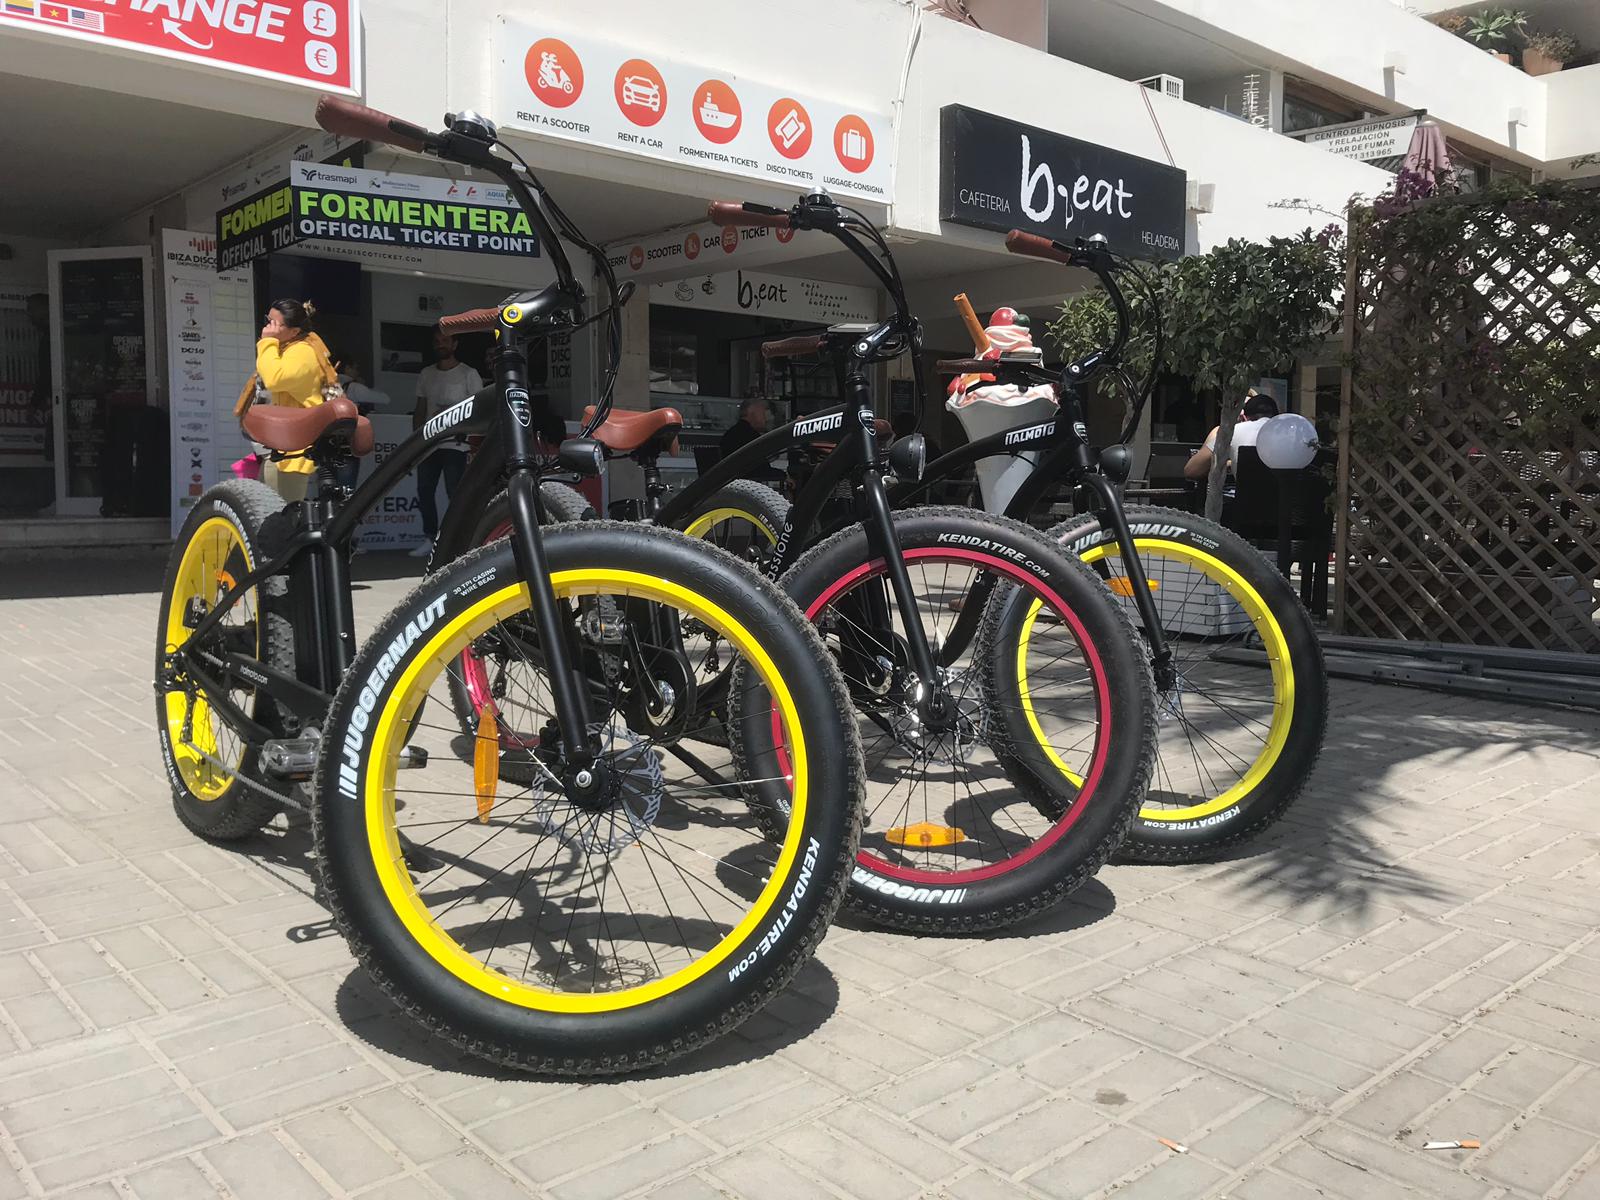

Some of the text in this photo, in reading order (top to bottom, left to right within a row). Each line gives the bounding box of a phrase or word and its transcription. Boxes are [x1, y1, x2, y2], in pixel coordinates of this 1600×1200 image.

[104, 0, 291, 42] ANGE
[516, 111, 590, 134] RENT A SCOOTER
[1315, 119, 1407, 140] CENTRO DE HIPNOSIS
[617, 132, 663, 149] RENT A CAR
[1335, 131, 1390, 145] RELAJACIÓN
[1351, 143, 1363, 151] DE
[1364, 139, 1396, 149] FUMAR
[679, 146, 759, 169] FORMENTERA TICKETS
[1359, 150, 1375, 159] 313
[318, 171, 358, 184] trasmapi
[766, 163, 814, 180] DISCO TICKETS
[823, 176, 884, 194] LUGGAGE-CONSIGNA
[300, 191, 533, 235] FORMENTERA
[959, 188, 1011, 214] CAFETERIA
[300, 219, 534, 252] OFFICIAL TICKET POINT
[1141, 230, 1180, 251] HELADERIA
[222, 235, 267, 268] OFFICIAL
[647, 244, 682, 260] SCOOTER
[703, 237, 721, 248] CAR
[423, 395, 475, 440] ITALMOTO
[793, 412, 844, 437] ITALMOTO
[1004, 421, 1056, 445] ITALMOTO
[1072, 523, 1187, 553] JUGGRNAUT
[937, 533, 1051, 579] KENDATIRE.COM
[453, 567, 497, 595] 30 TPI CASING
[461, 574, 496, 597] WIRE BEAD
[342, 593, 448, 768] JUGGERNAUT
[1143, 805, 1241, 831] KENDATIRE.COM
[728, 836, 821, 983] KENDATIRE.COM
